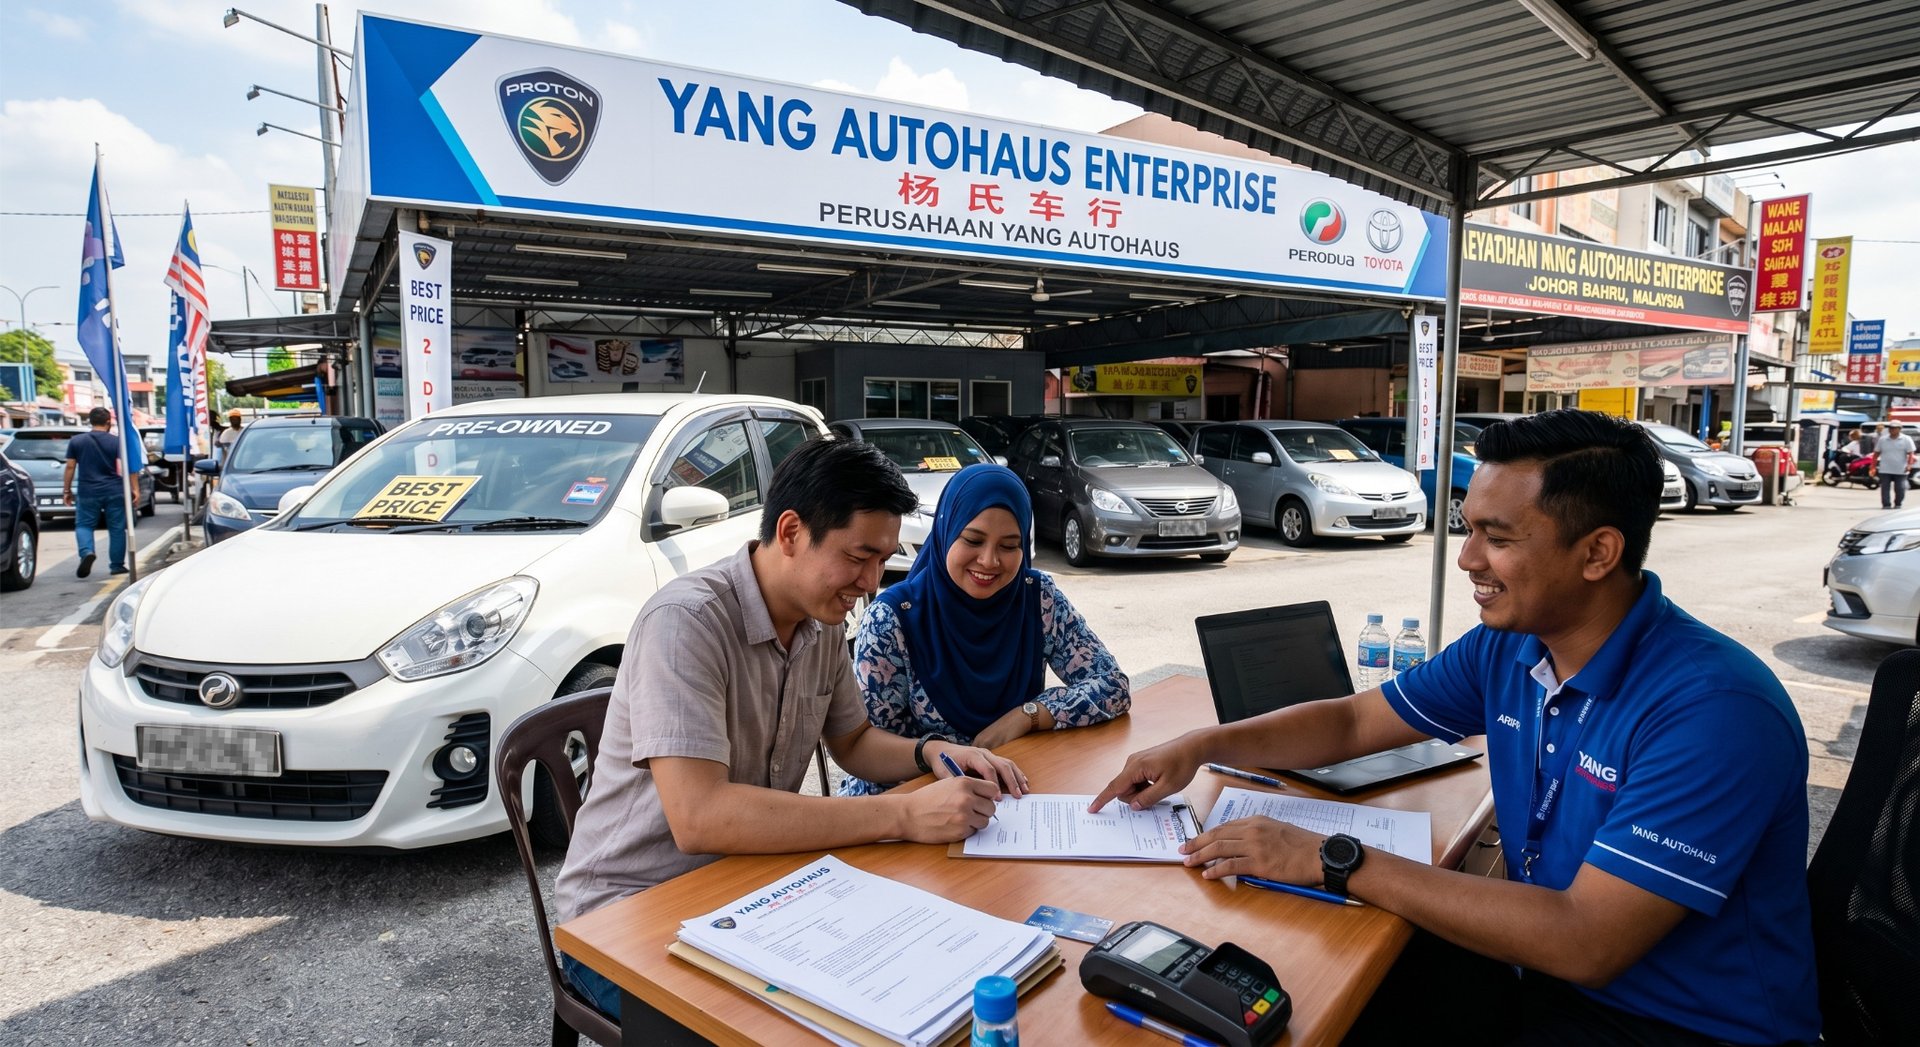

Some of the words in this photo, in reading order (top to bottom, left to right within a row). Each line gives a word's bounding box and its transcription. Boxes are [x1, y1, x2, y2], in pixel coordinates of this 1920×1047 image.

[506, 81, 594, 108] PROTON
[657, 78, 817, 151] YANG
[831, 107, 1071, 187] AUTOHAUS
[1085, 146, 1277, 215] ENTERPRISE
[1767, 201, 1801, 218] WANE
[819, 202, 993, 239] PERUSAHAAN
[1001, 223, 1062, 246] YANG
[1067, 231, 1180, 258] AUTOHAUS
[1763, 219, 1804, 236] MALAN
[1364, 256, 1404, 272] TOYOTA
[1579, 250, 1652, 285] AUTOHAUS
[1653, 261, 1725, 296] ENTERPRISE
[410, 280, 442, 300] BEST
[1529, 275, 1578, 296] JOHOR
[1582, 282, 1630, 304] BAHRU,
[1632, 289, 1684, 310] MALAYSIA
[410, 304, 444, 324] PRICE
[1418, 343, 1433, 354] BEST
[427, 419, 612, 438] PRE-OWNED
[387, 482, 464, 497] BEST
[368, 500, 447, 516] PRICE
[1578, 750, 1618, 783] YANG
[1632, 824, 1659, 843] YANG
[1661, 837, 1717, 864] AUTOHAUS
[734, 897, 771, 916] YANG
[771, 867, 831, 899] AUTOHAUS
